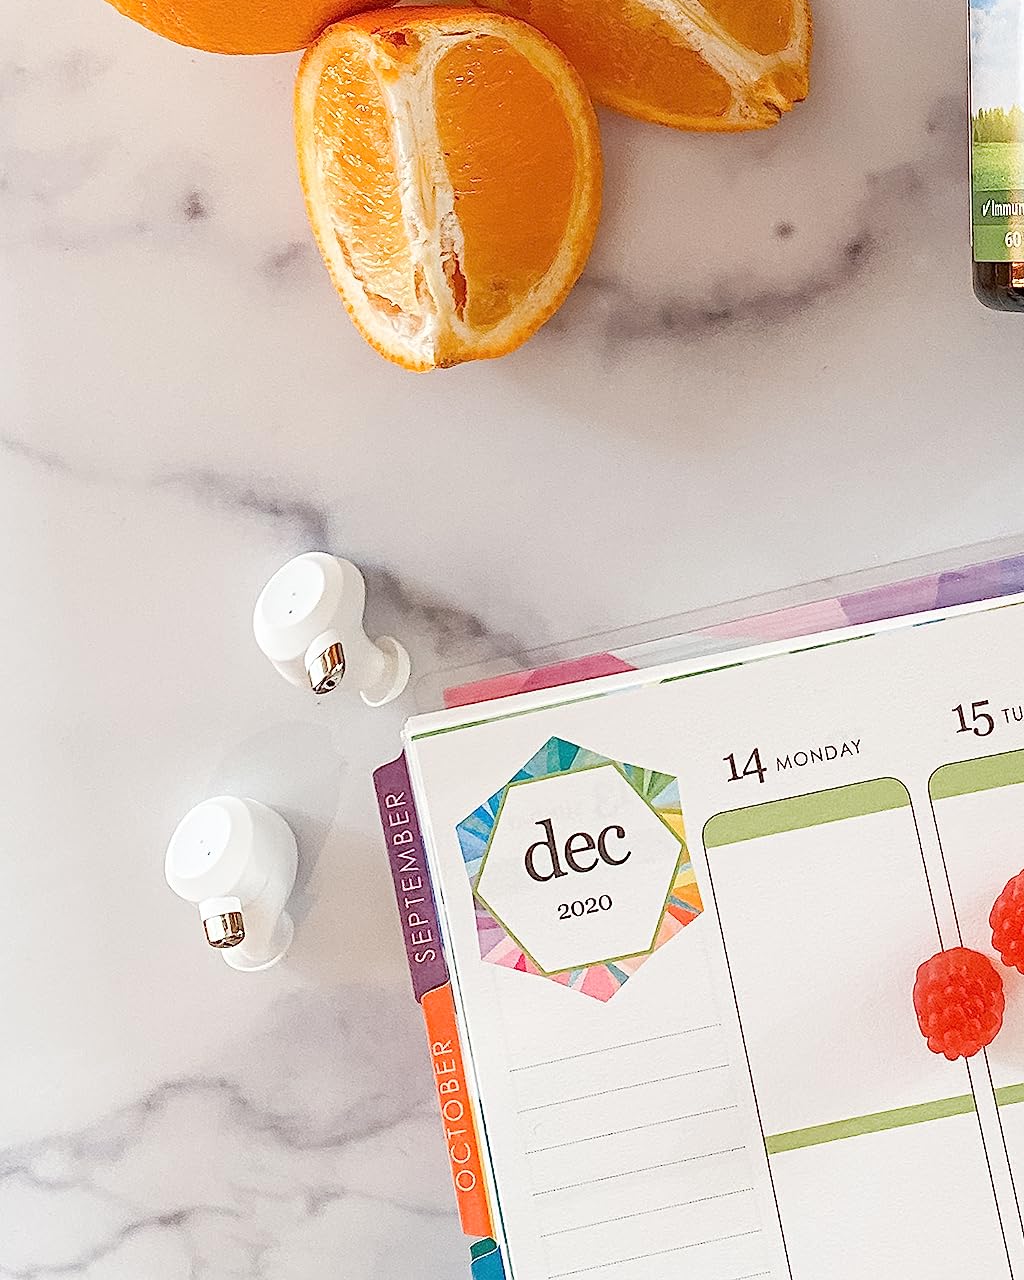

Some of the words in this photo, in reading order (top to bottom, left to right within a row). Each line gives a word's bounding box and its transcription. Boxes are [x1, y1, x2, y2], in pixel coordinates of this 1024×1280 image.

[1004, 231, 1021, 248] 60
[951, 700, 995, 737] 15
[723, 747, 767, 784] 14
[776, 739, 861, 772] MONDAY
[524, 818, 632, 883] dec
[385, 791, 436, 963] SEPTEMBER
[557, 894, 613, 920] 2020
[432, 1039, 477, 1192] OCTOBER
